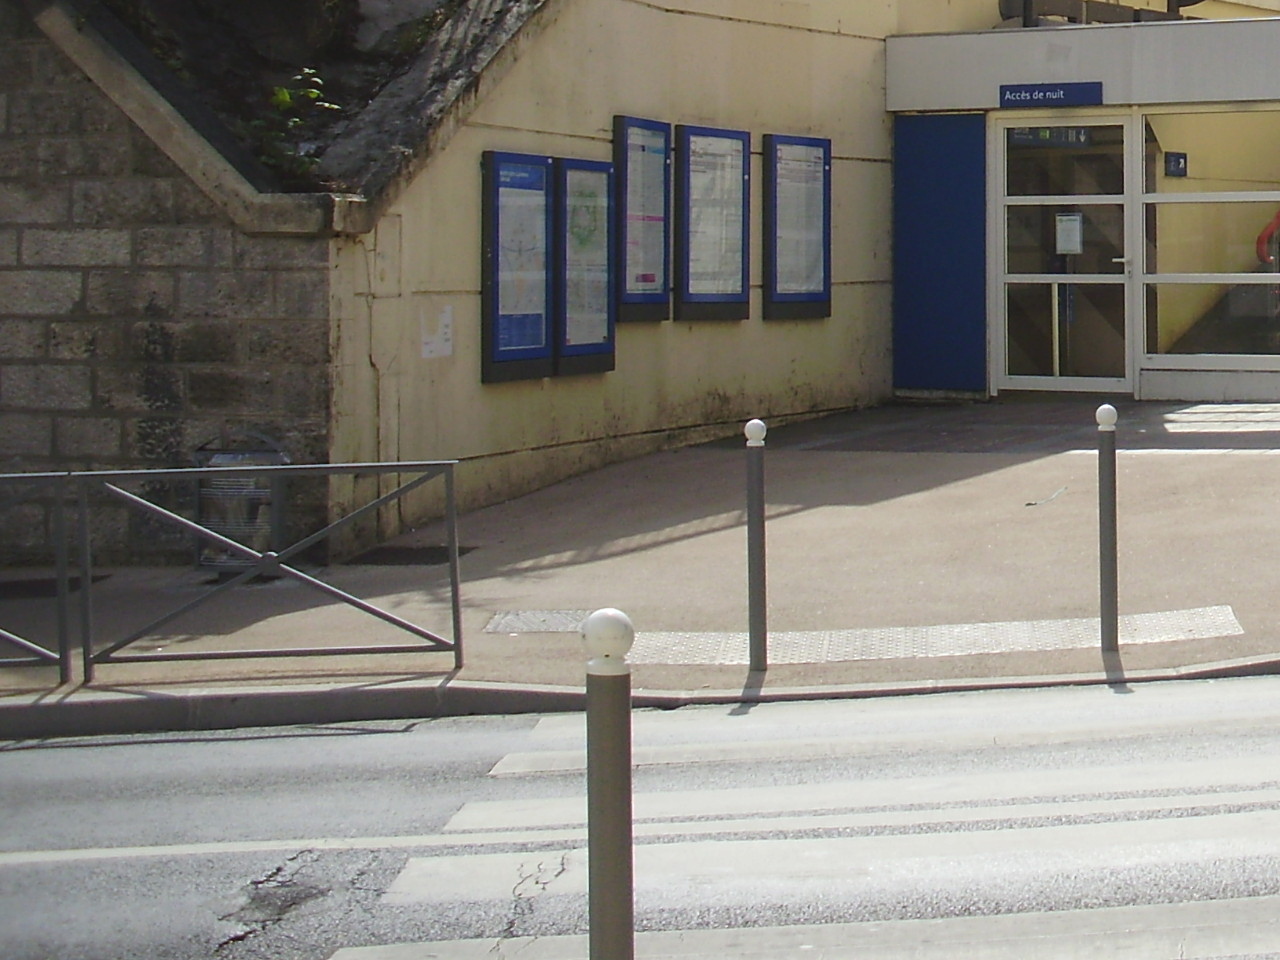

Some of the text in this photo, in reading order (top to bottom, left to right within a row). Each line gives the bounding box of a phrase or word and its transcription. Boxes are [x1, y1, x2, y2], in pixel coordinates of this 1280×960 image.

[1004, 89, 1064, 101] Accès de nuit
